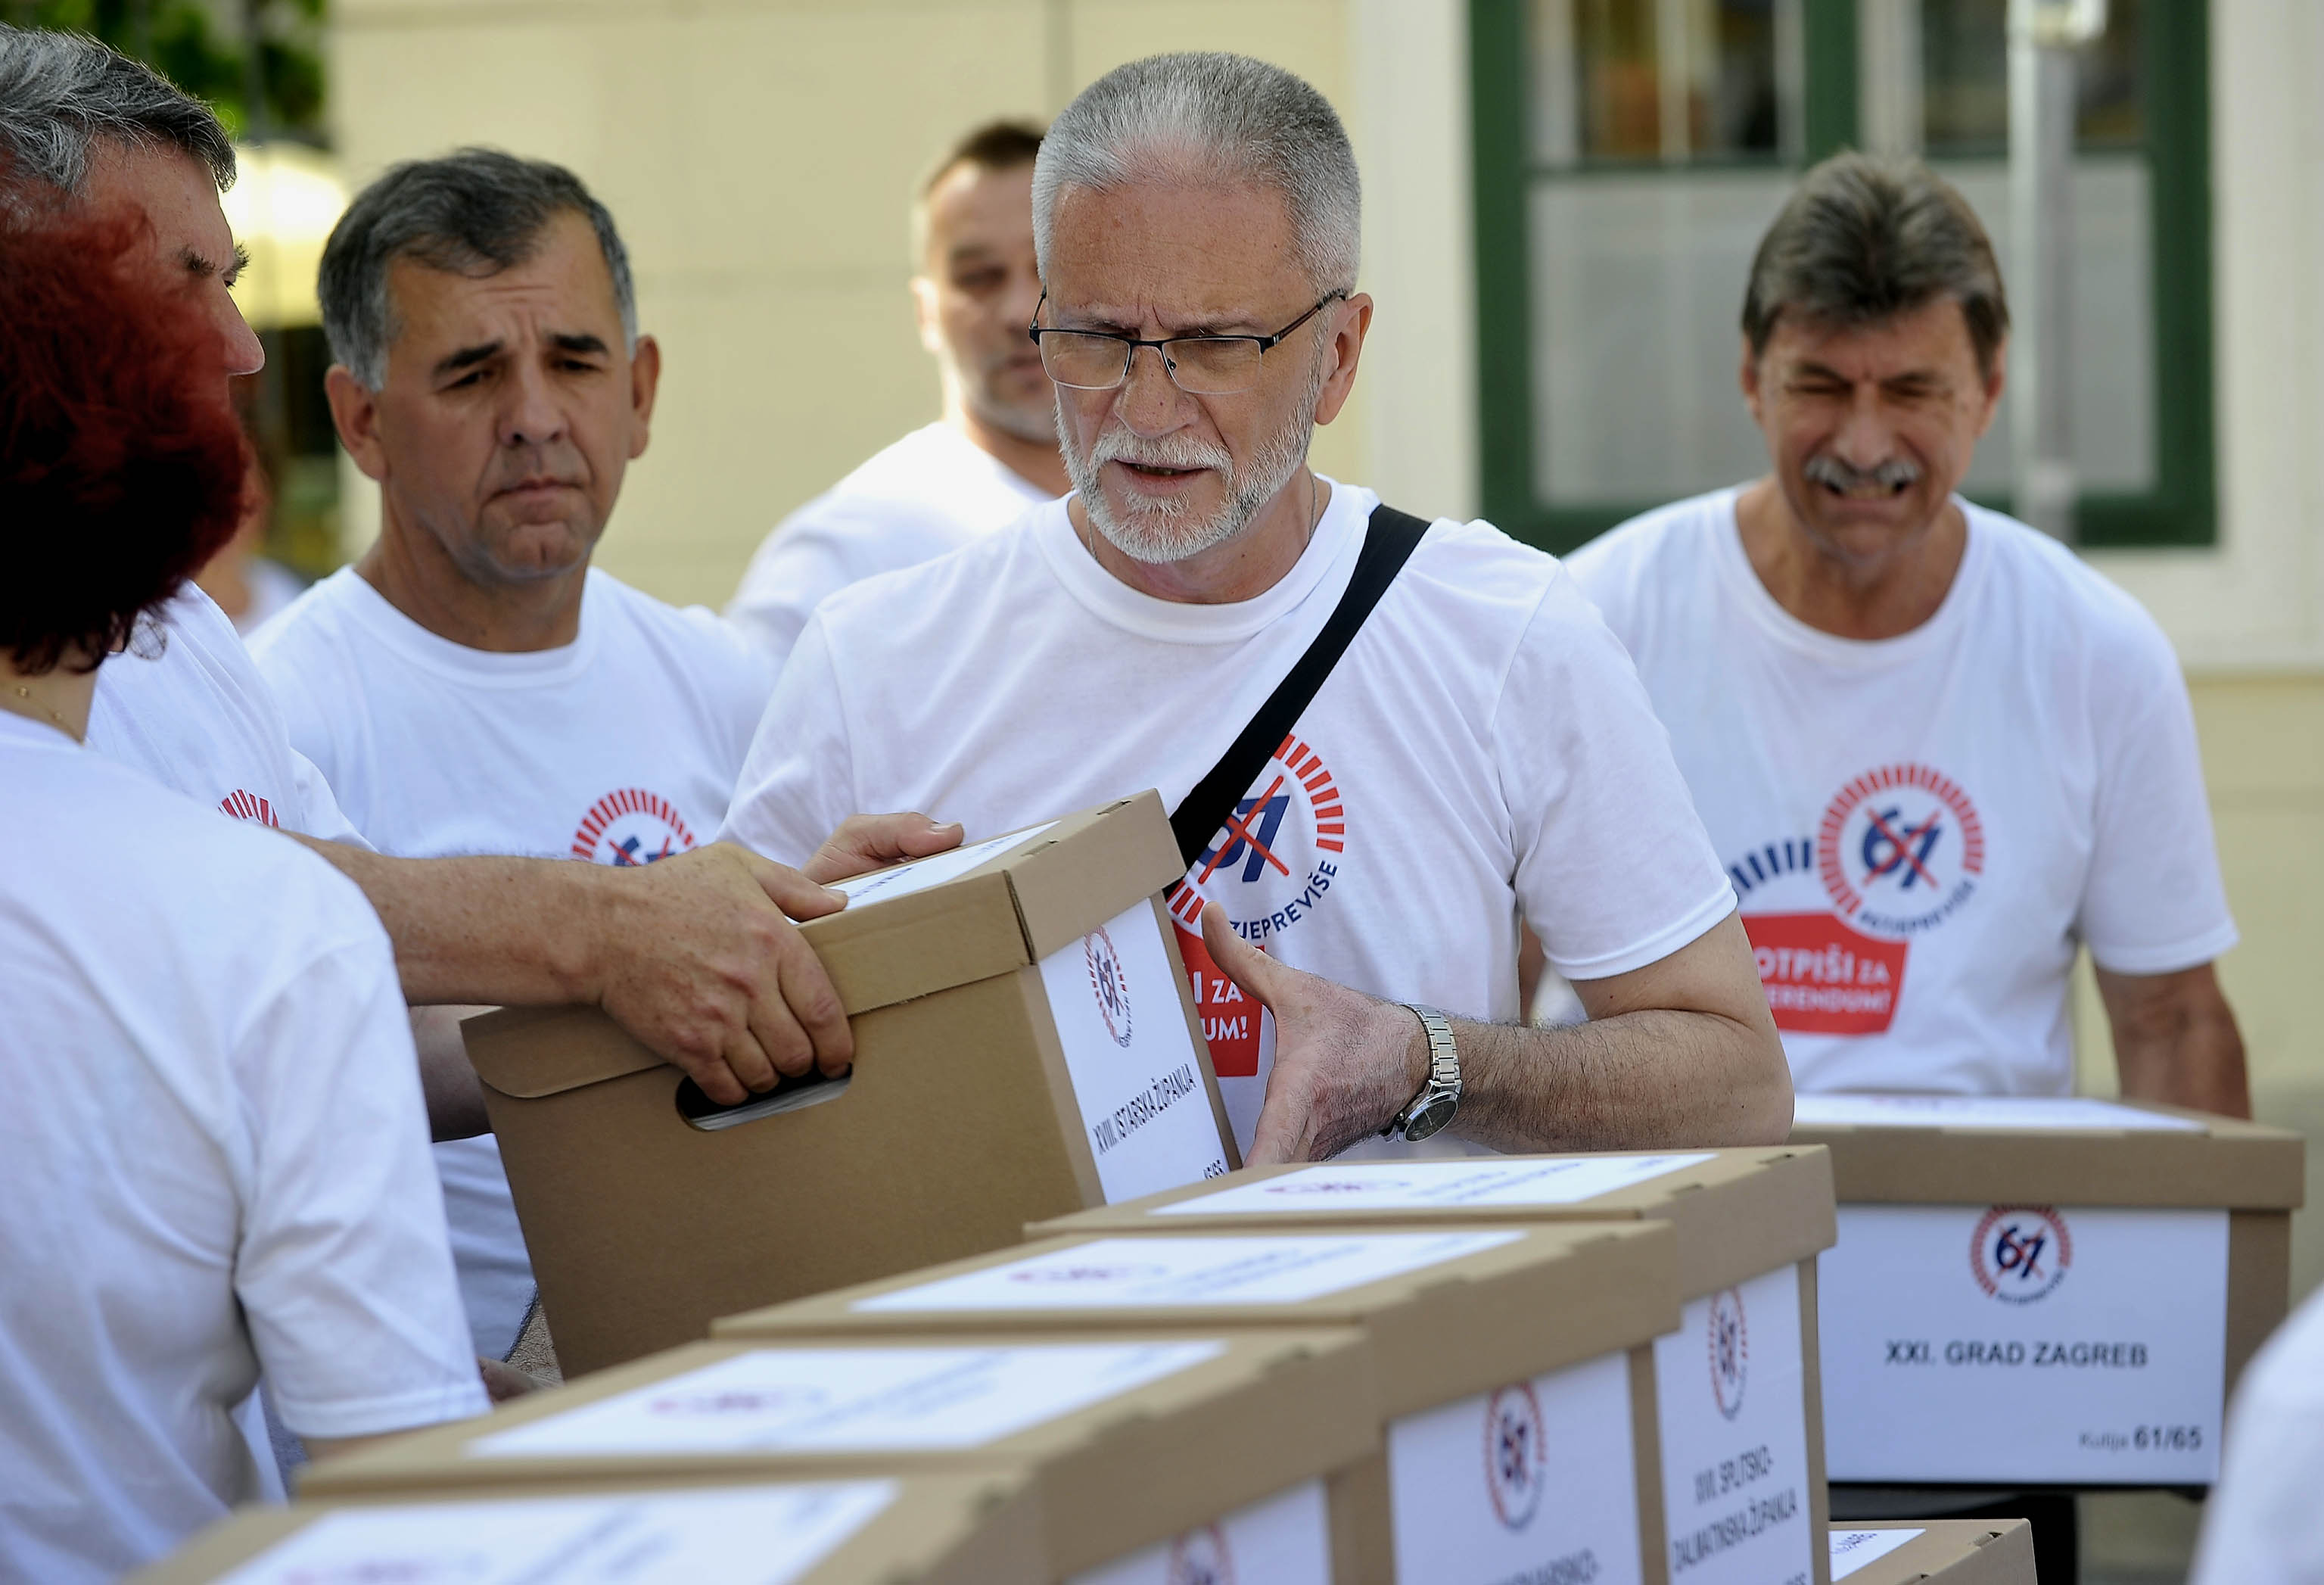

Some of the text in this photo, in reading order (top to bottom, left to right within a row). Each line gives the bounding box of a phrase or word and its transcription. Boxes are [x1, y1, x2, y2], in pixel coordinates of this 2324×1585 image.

[1862, 806, 1941, 889] 67
[1754, 943, 1890, 985] OTPIŠI ZA
[1212, 979, 1243, 1004] ZA
[1765, 984, 1891, 1014] ERENDUM!
[1150, 1063, 1197, 1111] ŽUPANIJA
[1996, 1224, 2046, 1278] 67
[1885, 1340, 2148, 1368] XXI. GRAD ZAGREB
[2134, 1424, 2204, 1452] 61/65
